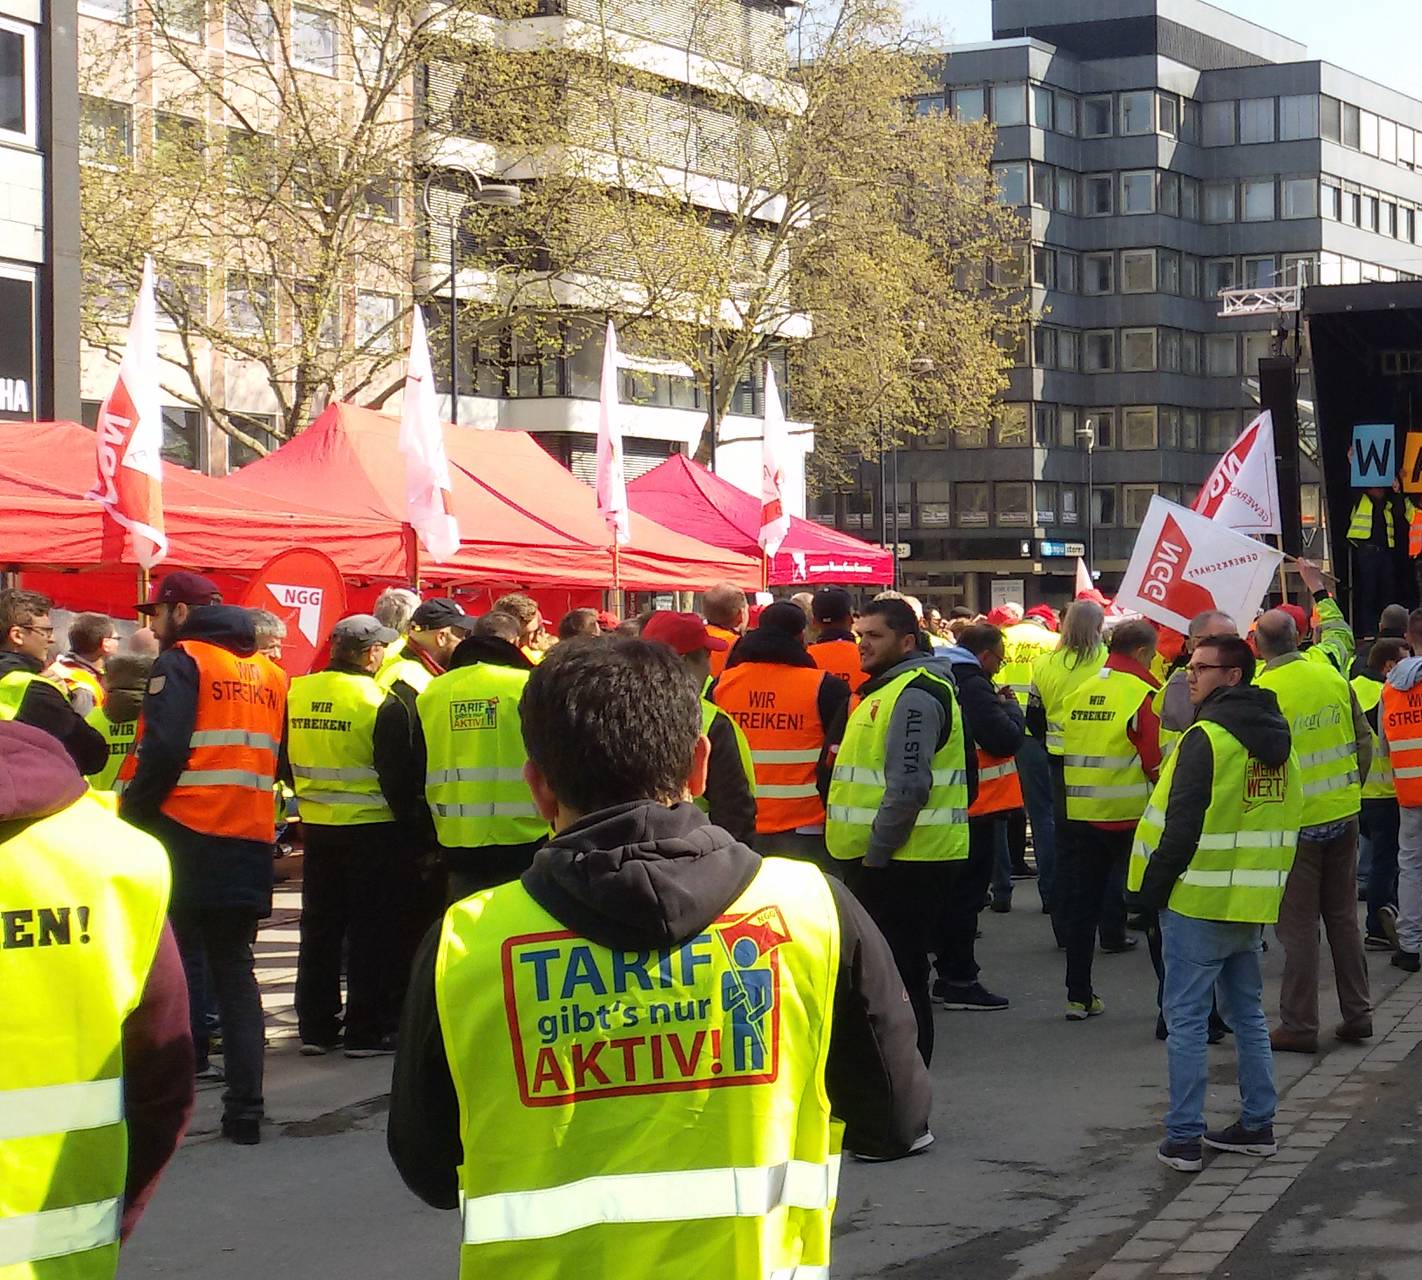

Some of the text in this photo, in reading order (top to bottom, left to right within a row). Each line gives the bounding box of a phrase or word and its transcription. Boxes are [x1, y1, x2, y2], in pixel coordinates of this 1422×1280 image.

[284, 589, 320, 606] NGG
[312, 701, 333, 713] WIR
[749, 691, 776, 709] WIR
[109, 724, 135, 736] WIR
[291, 718, 352, 732] STREIKEN!
[757, 910, 776, 924] NGG
[1, 906, 91, 950] EN!
[520, 934, 713, 1002] TARIF
[650, 998, 712, 1025] nur
[532, 1029, 723, 1093] AKTIV!
